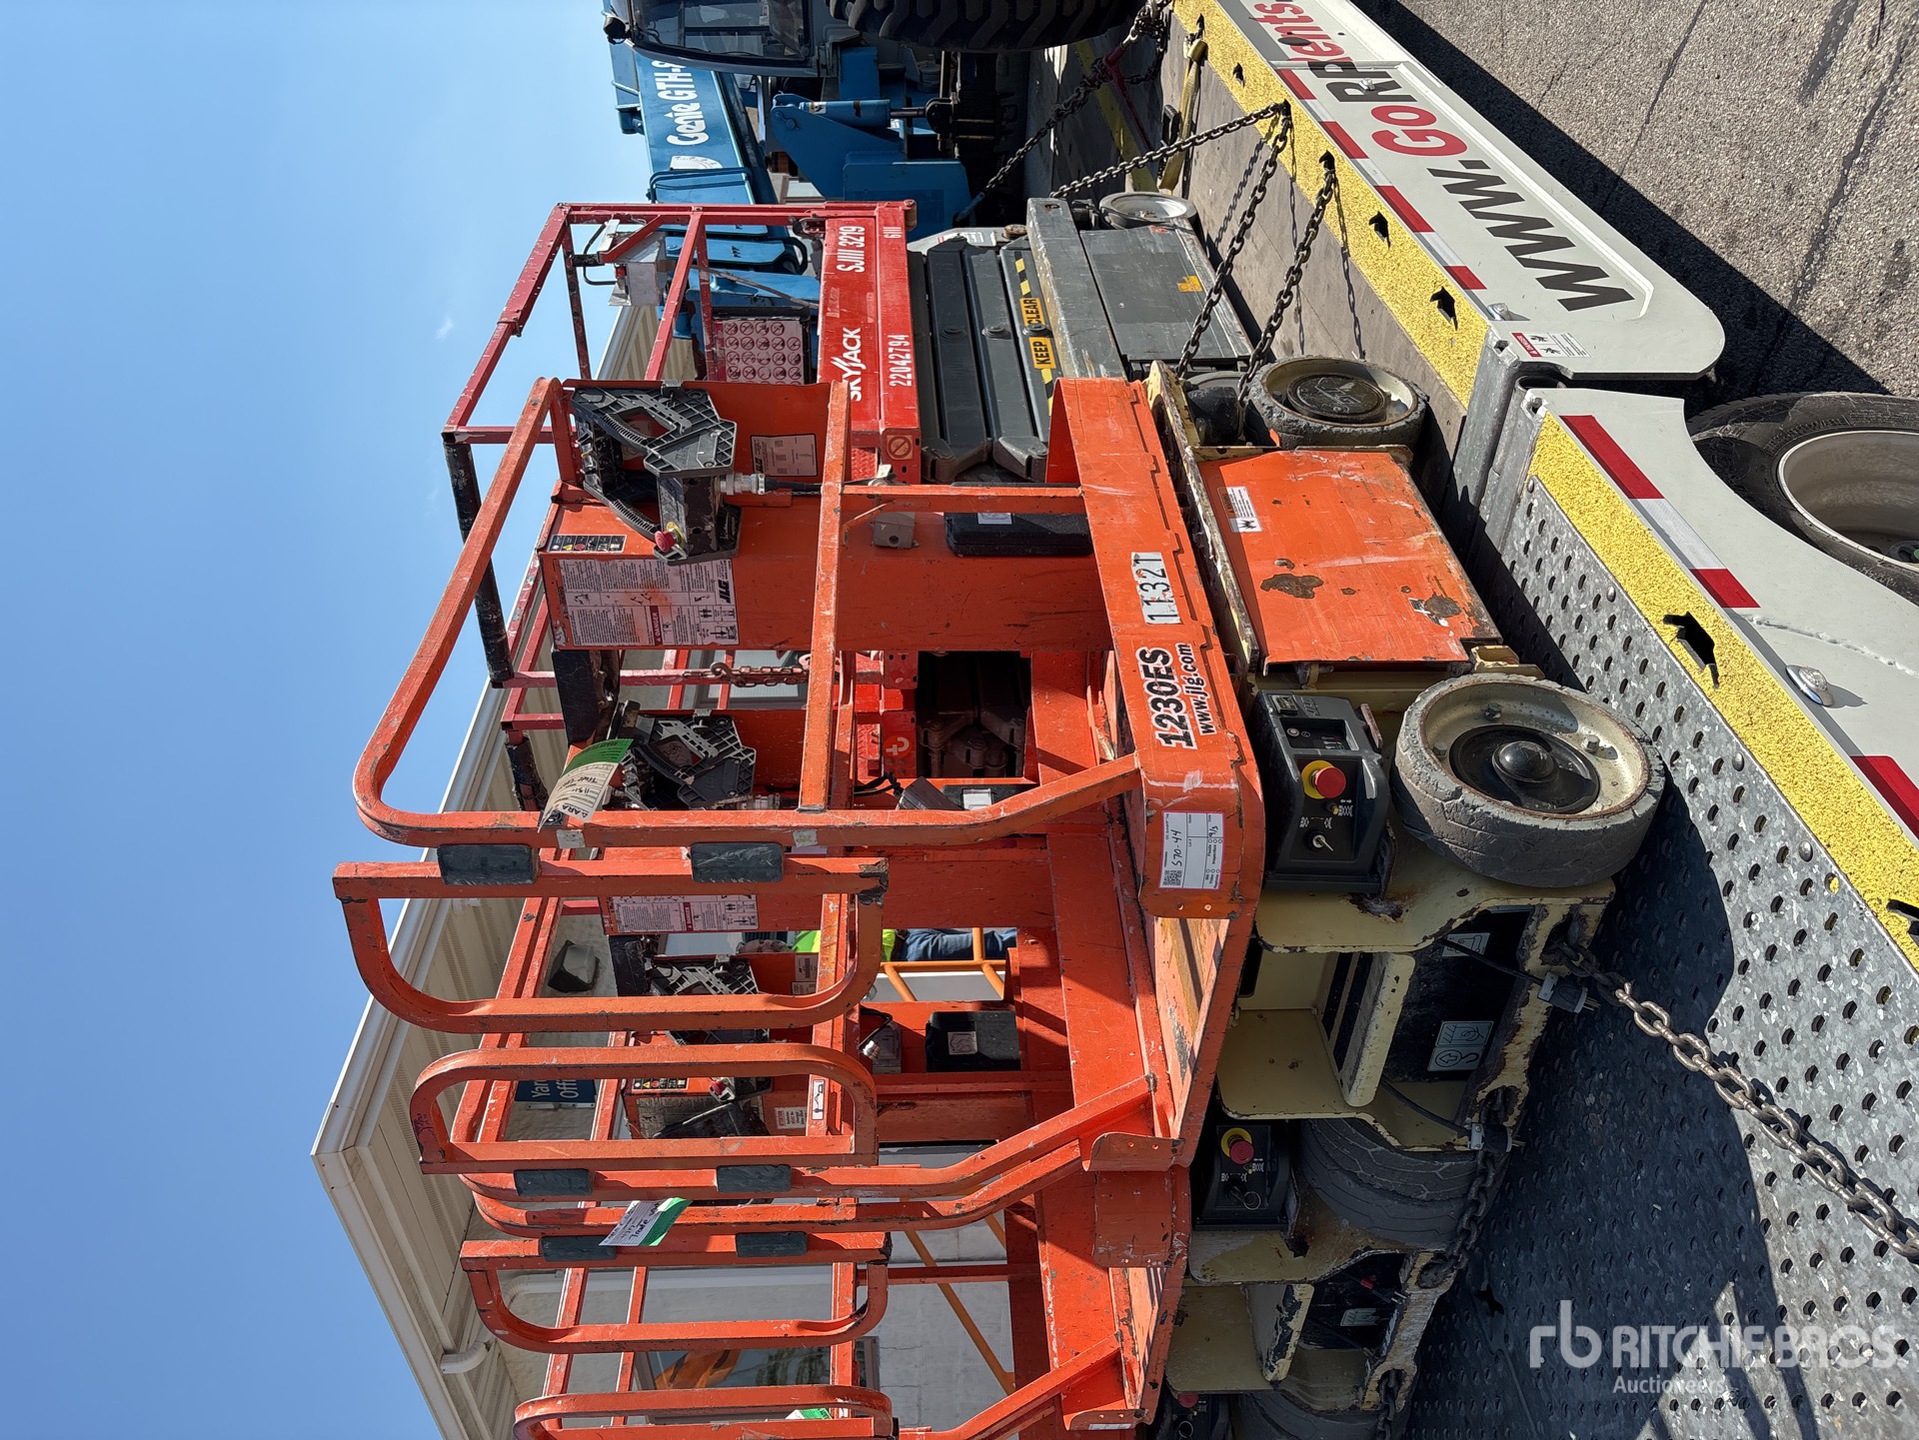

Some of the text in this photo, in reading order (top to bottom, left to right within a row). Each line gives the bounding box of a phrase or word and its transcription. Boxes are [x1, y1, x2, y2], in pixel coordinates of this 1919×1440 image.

[652, 60, 709, 145] Genie GTH-8
[838, 226, 865, 248] 3219
[1025, 299, 1050, 365] KEEP CLEAR
[831, 328, 866, 402] SKYJACK
[888, 334, 912, 386] 22042794
[718, 580, 731, 603] JLG
[652, 612, 660, 636] DANGER
[1133, 558, 1194, 747] 1230ES 11321
[1176, 644, 1214, 734] www.jlg.com
[531, 1080, 550, 1098] Yar
[556, 1080, 578, 1098] Offi
